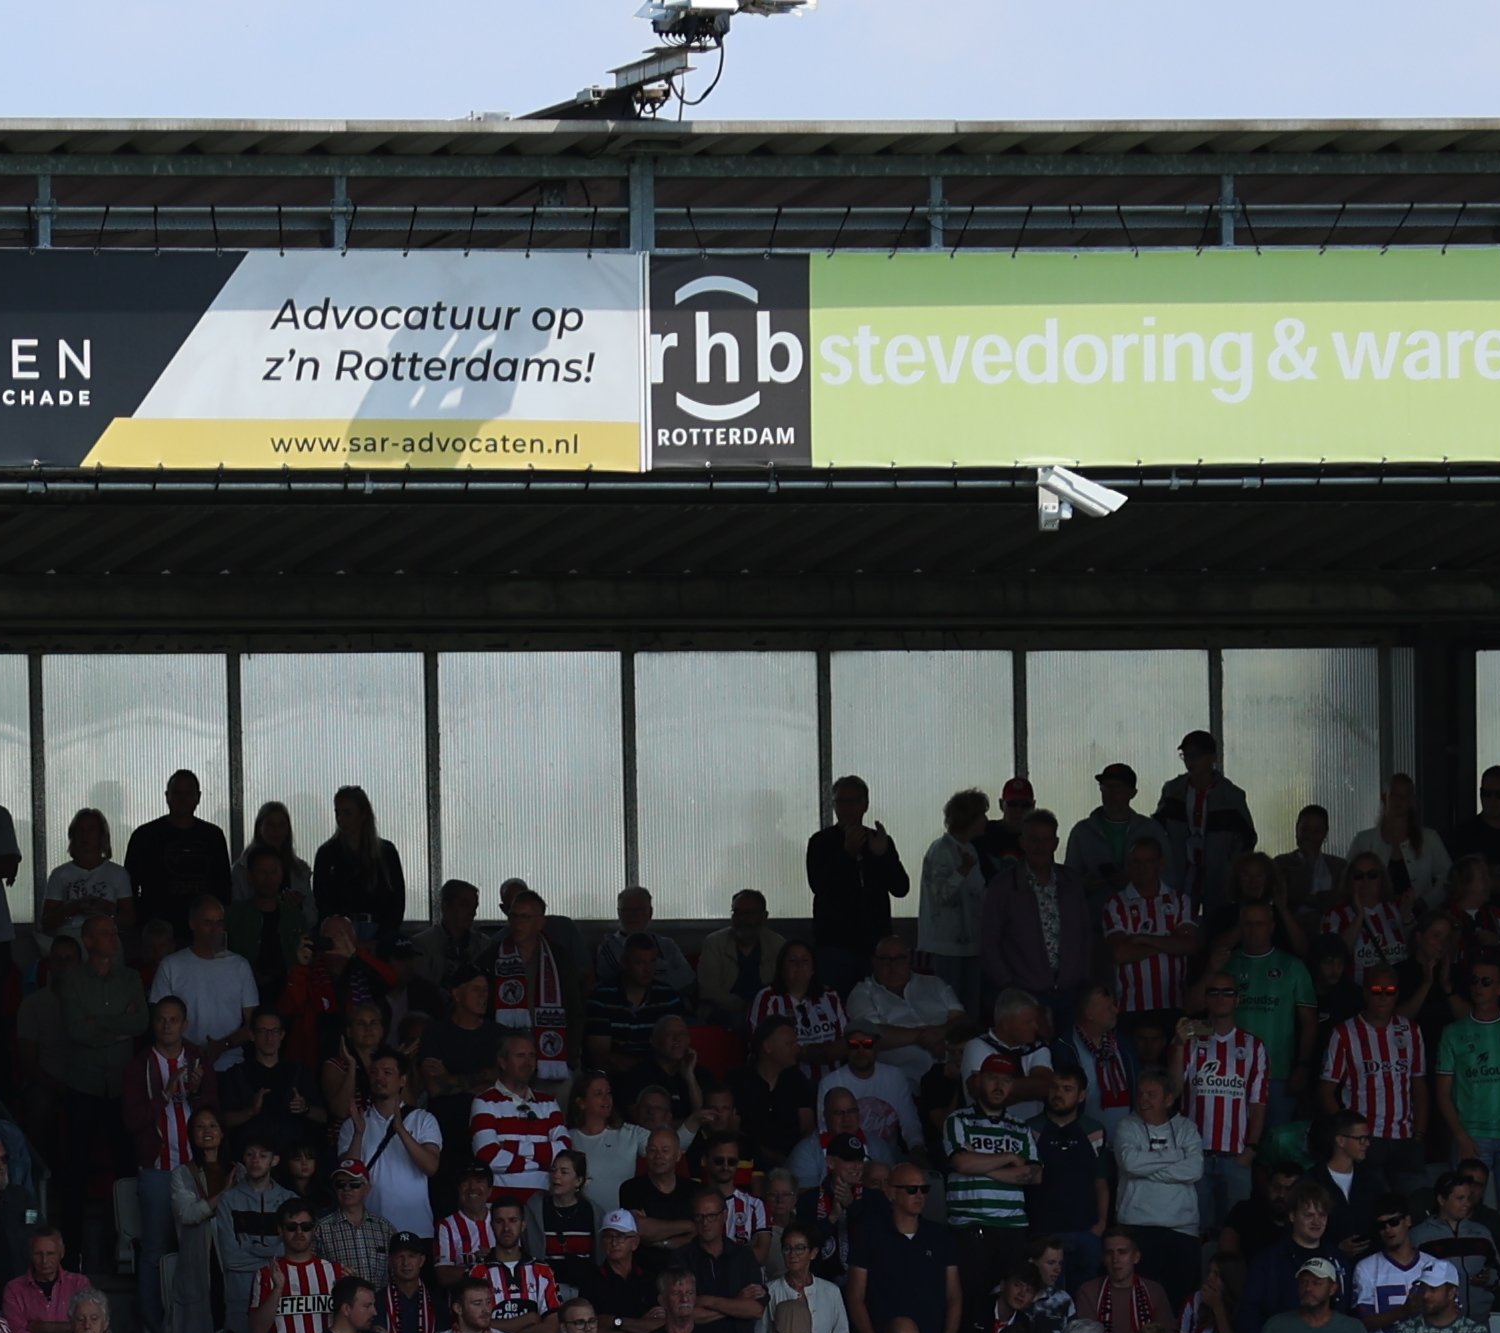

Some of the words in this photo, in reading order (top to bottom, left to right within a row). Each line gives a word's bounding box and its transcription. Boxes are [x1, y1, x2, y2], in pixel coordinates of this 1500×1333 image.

[271, 298, 520, 332] Advocatuur
[532, 307, 585, 342] op
[650, 308, 805, 385] rhb
[333, 348, 596, 385] Rotterdams!
[820, 314, 1252, 403] stevedoring
[1267, 318, 1319, 382] &
[269, 433, 580, 457] www.sar-advocaten.nl
[657, 426, 795, 447] ROTTERDAM
[1363, 1058, 1408, 1075] D&S
[1466, 1065, 1480, 1077] de
[1188, 1074, 1202, 1087] de
[1203, 1074, 1244, 1088] Goudse
[967, 1136, 1016, 1152] aegis
